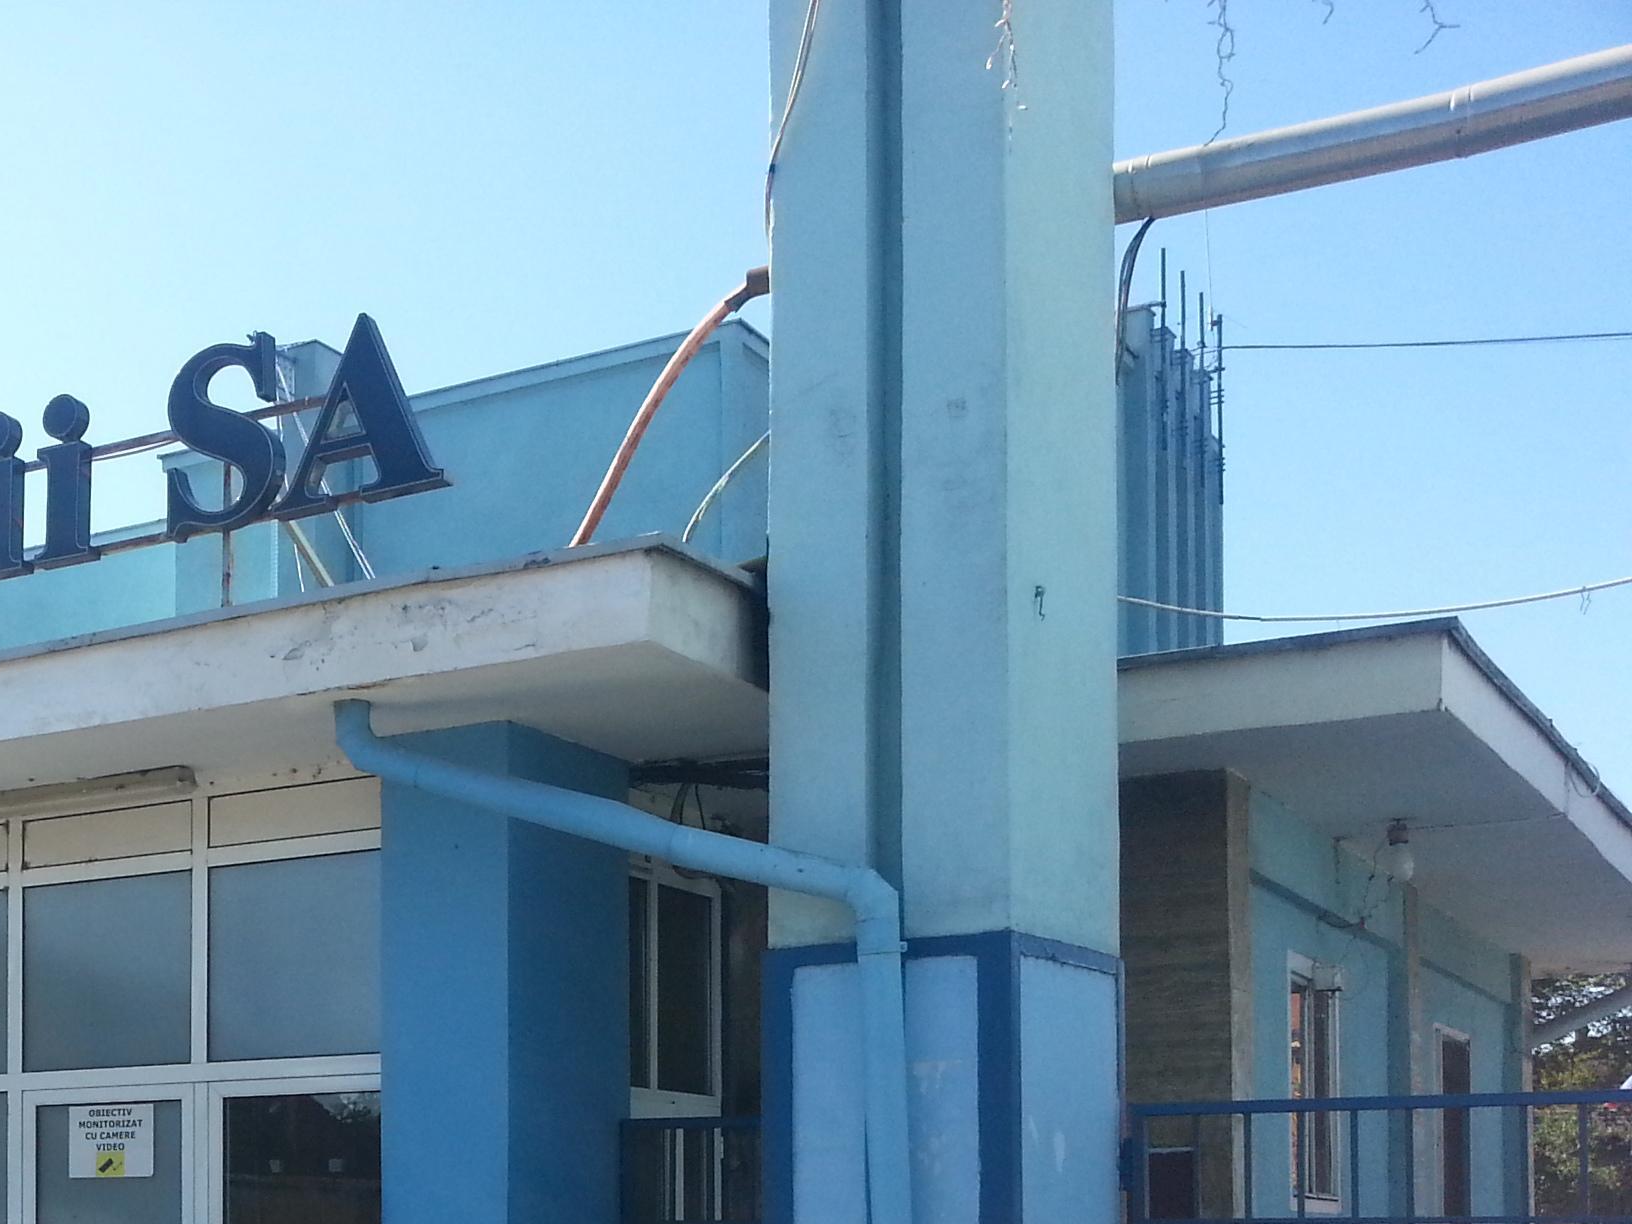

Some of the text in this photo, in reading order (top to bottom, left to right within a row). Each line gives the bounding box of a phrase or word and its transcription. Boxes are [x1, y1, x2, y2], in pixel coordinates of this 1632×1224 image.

[167, 312, 452, 544] SA
[88, 1108, 132, 1117] OBIECTIV
[78, 1119, 143, 1129] MONITORIZAT
[85, 1130, 136, 1140] CU CAMERE
[96, 1142, 125, 1151] VIDEO
